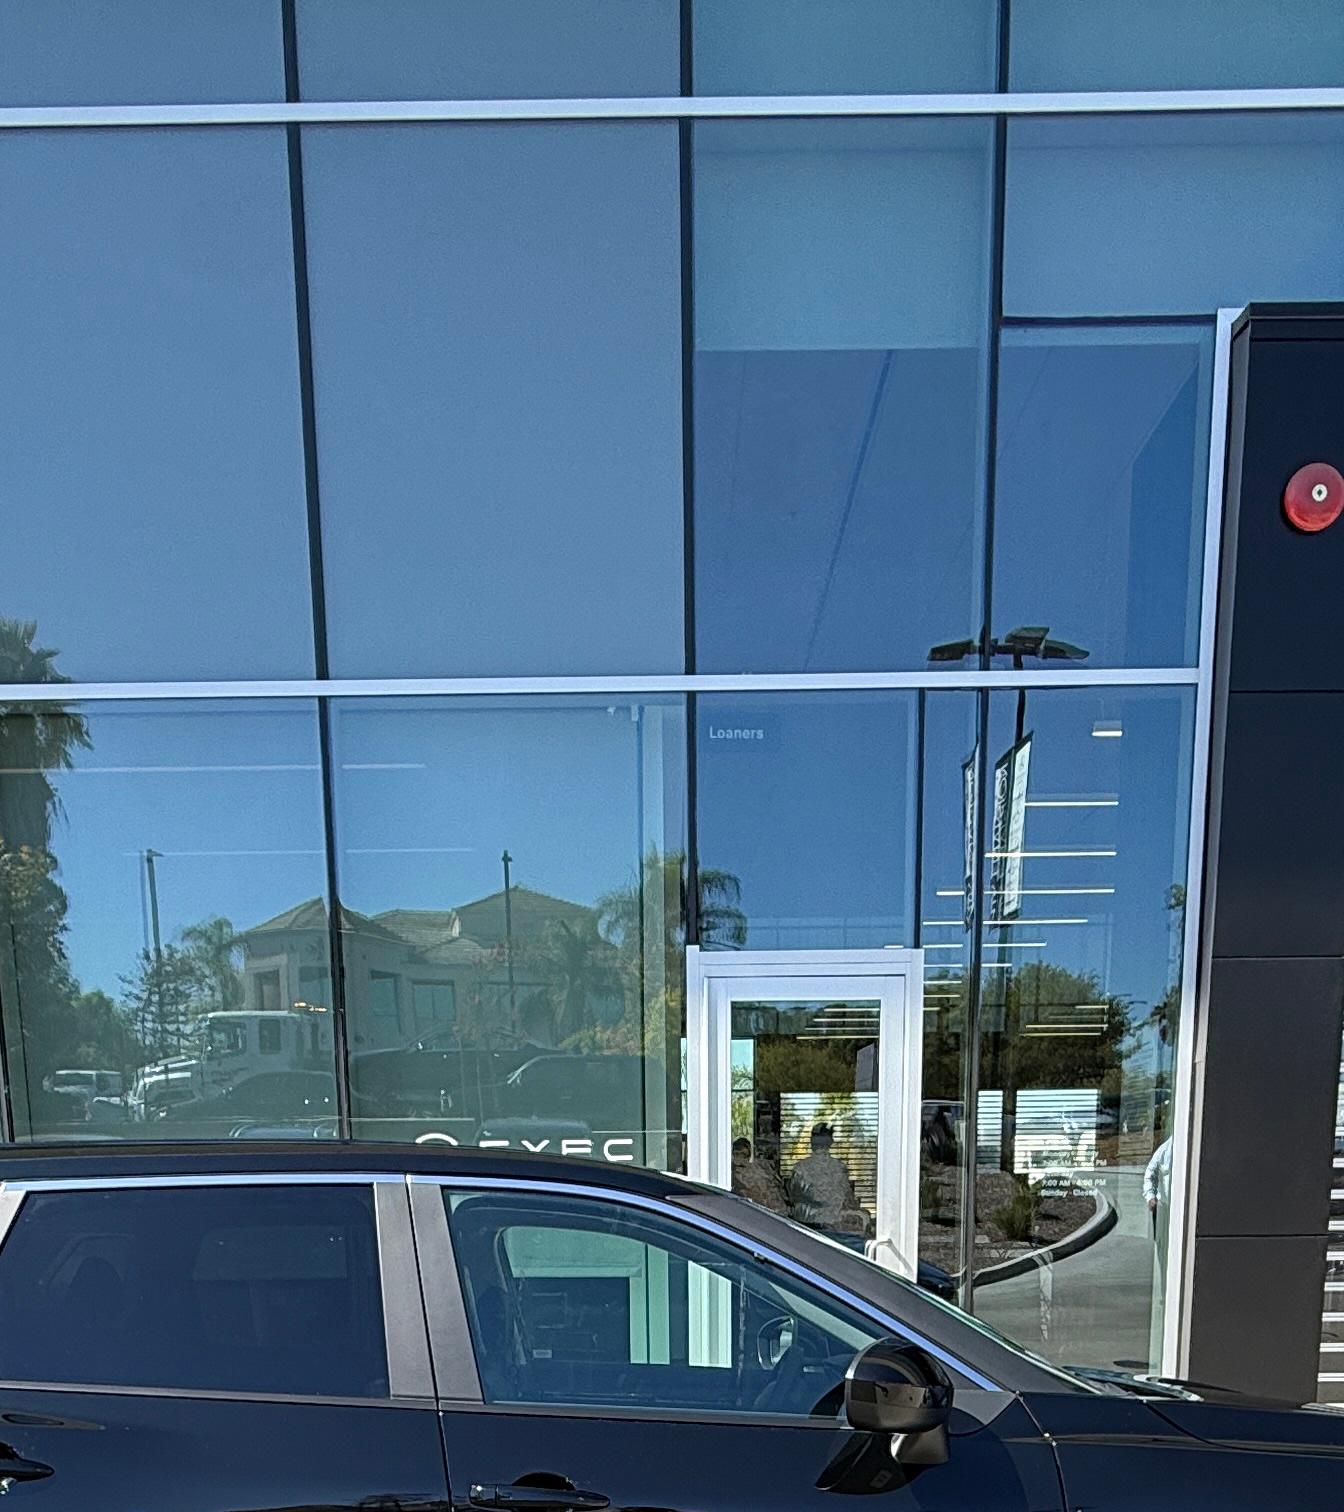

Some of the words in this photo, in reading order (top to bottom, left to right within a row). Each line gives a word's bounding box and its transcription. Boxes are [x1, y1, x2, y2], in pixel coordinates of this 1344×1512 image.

[709, 725, 765, 740] Loaners
[1058, 1179, 1071, 1187] AM
[1094, 1179, 1107, 1187] PM
[1040, 1189, 1069, 1198] Sunday
[1072, 1188, 1098, 1197] Closed
